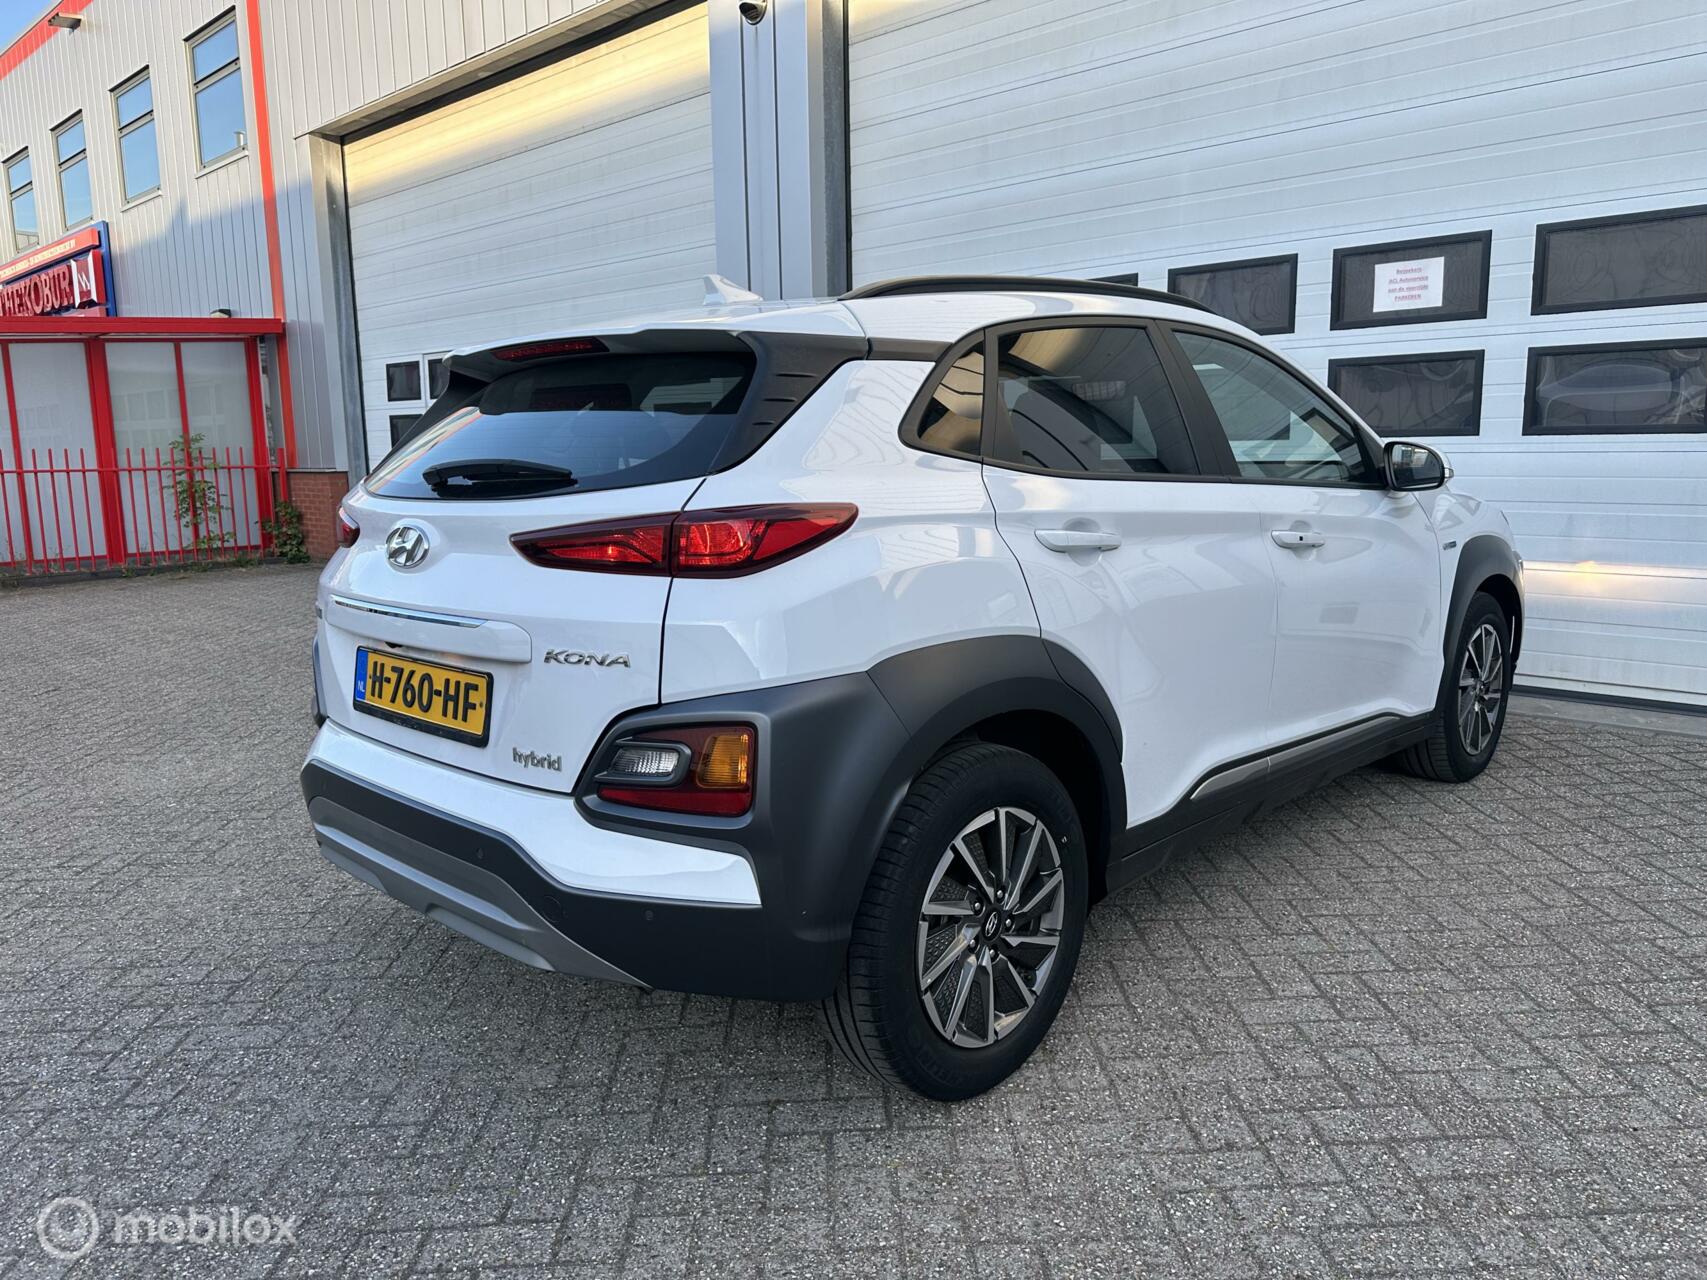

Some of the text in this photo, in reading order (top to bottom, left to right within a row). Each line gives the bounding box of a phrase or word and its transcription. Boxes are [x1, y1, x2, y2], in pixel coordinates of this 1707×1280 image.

[543, 649, 632, 669] KONA
[357, 680, 366, 693] NL
[369, 660, 480, 723] H-760-HF
[512, 747, 563, 772] hybrid
